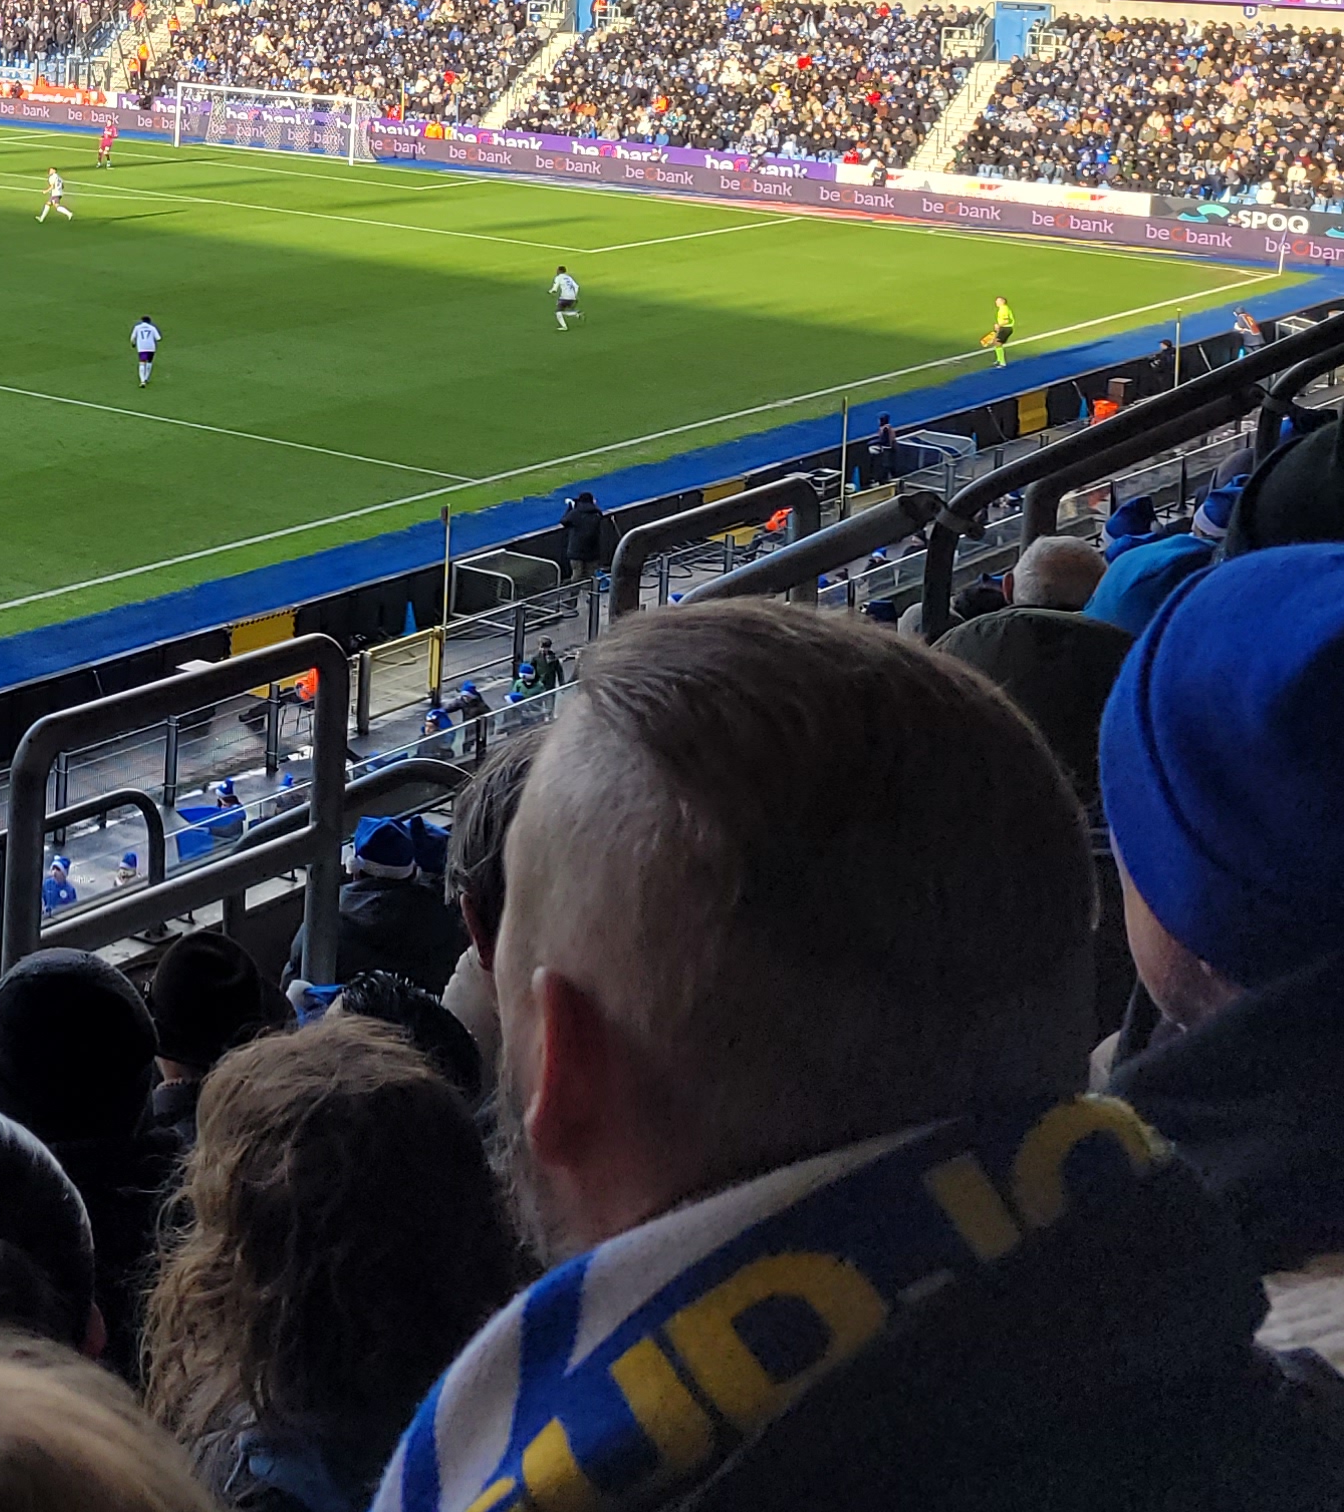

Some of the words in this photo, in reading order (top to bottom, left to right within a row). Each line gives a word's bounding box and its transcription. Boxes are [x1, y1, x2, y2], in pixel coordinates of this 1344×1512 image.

[1246, 6, 1256, 16] D
[1238, 210, 1309, 234] SPOQ
[1265, 237, 1344, 261] beoban
[141, 330, 152, 340] 17
